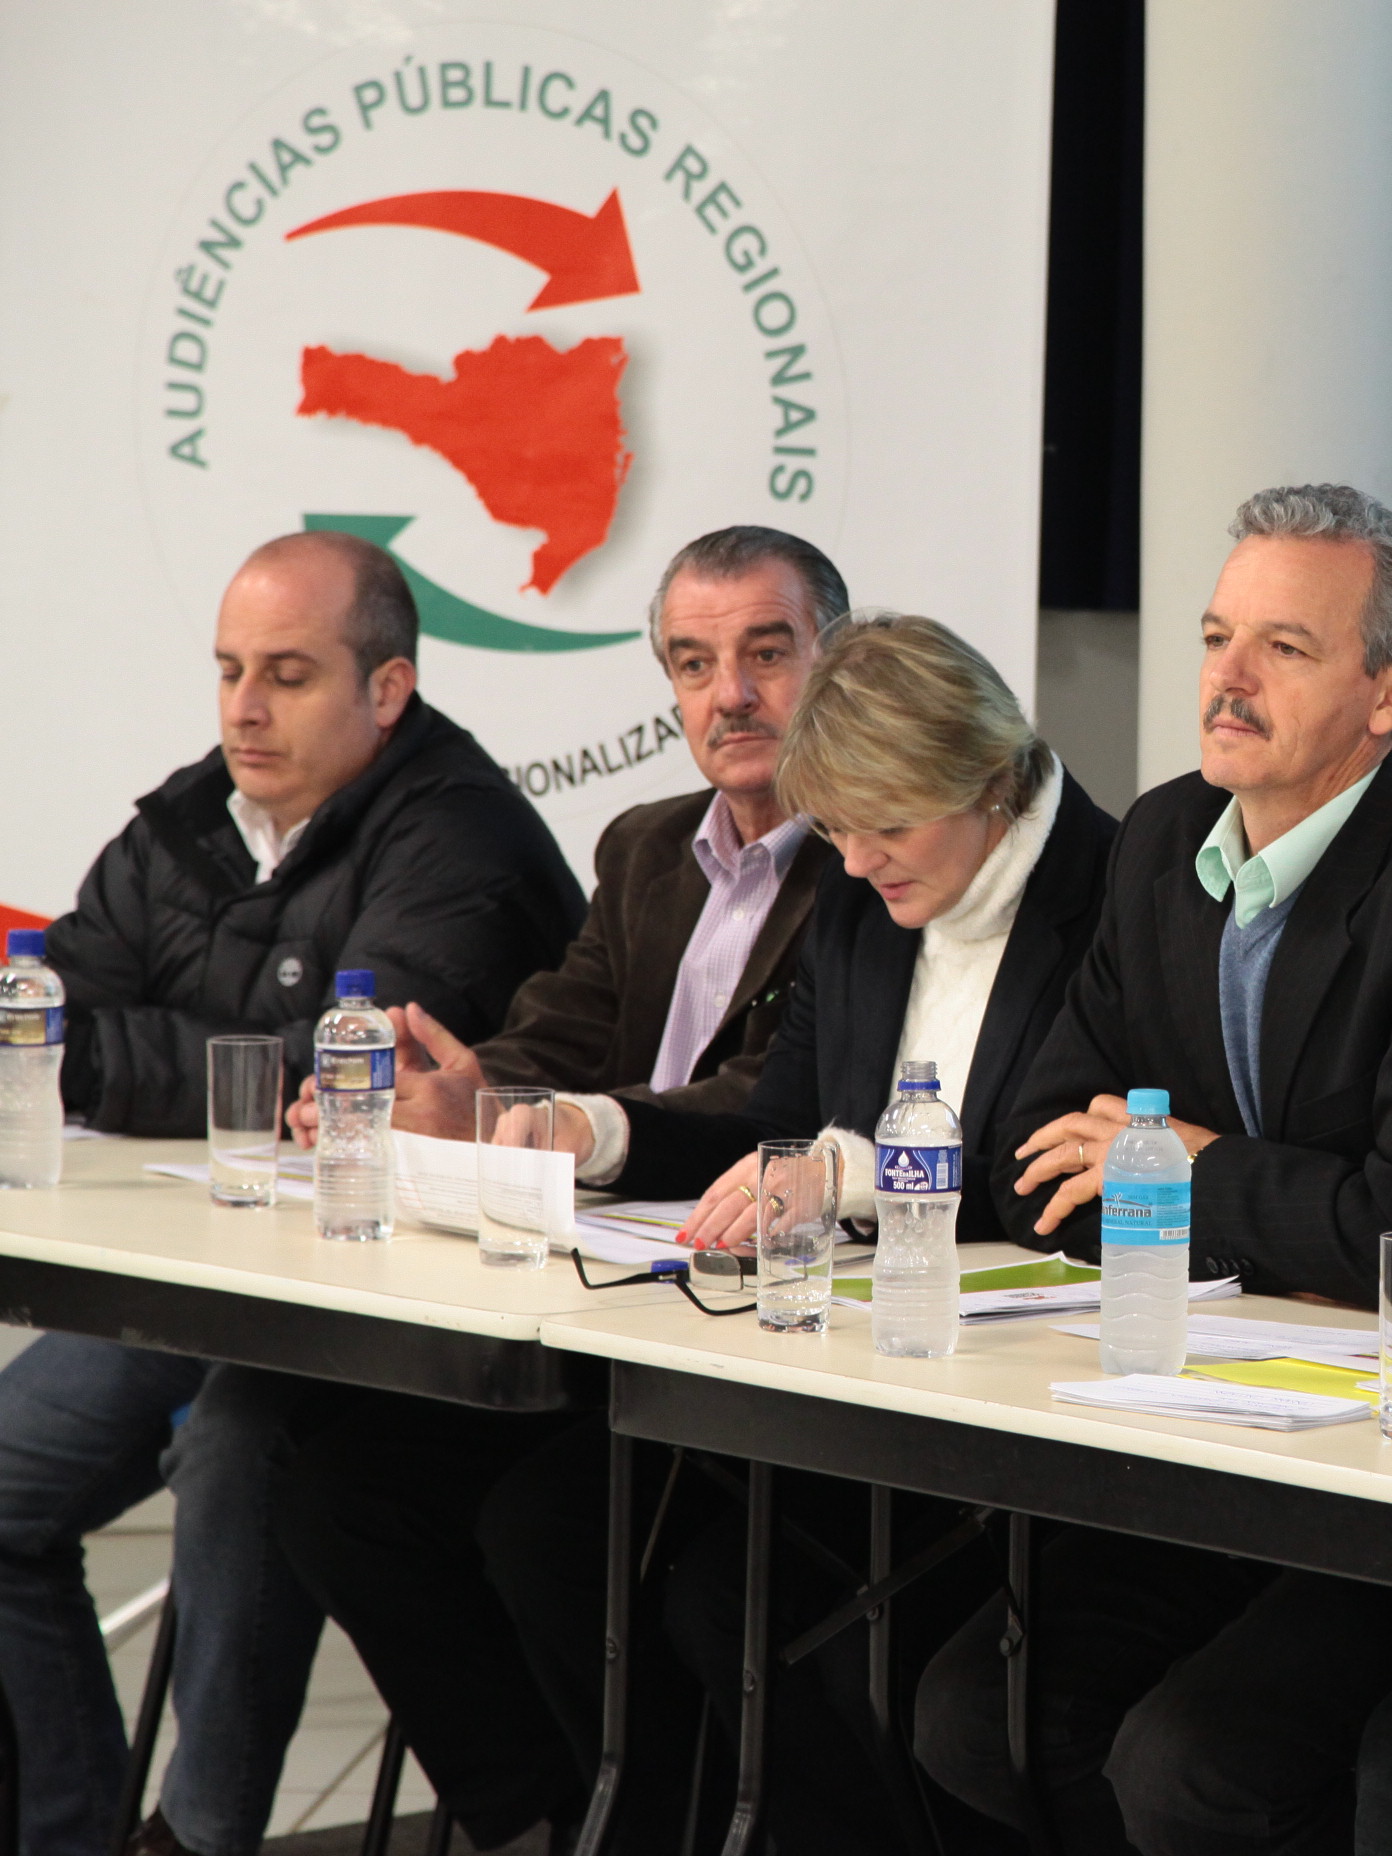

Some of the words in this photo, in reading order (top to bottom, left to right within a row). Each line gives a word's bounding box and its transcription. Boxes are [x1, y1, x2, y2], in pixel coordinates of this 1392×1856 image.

[166, 106, 342, 468] AUDIÊNCIAS
[353, 56, 659, 158] PÚBLICAS
[665, 144, 817, 503] REGIONAIS
[502, 704, 684, 797] IONALIZA
[893, 1181, 905, 1190] 500
[906, 1182, 914, 1190] ml
